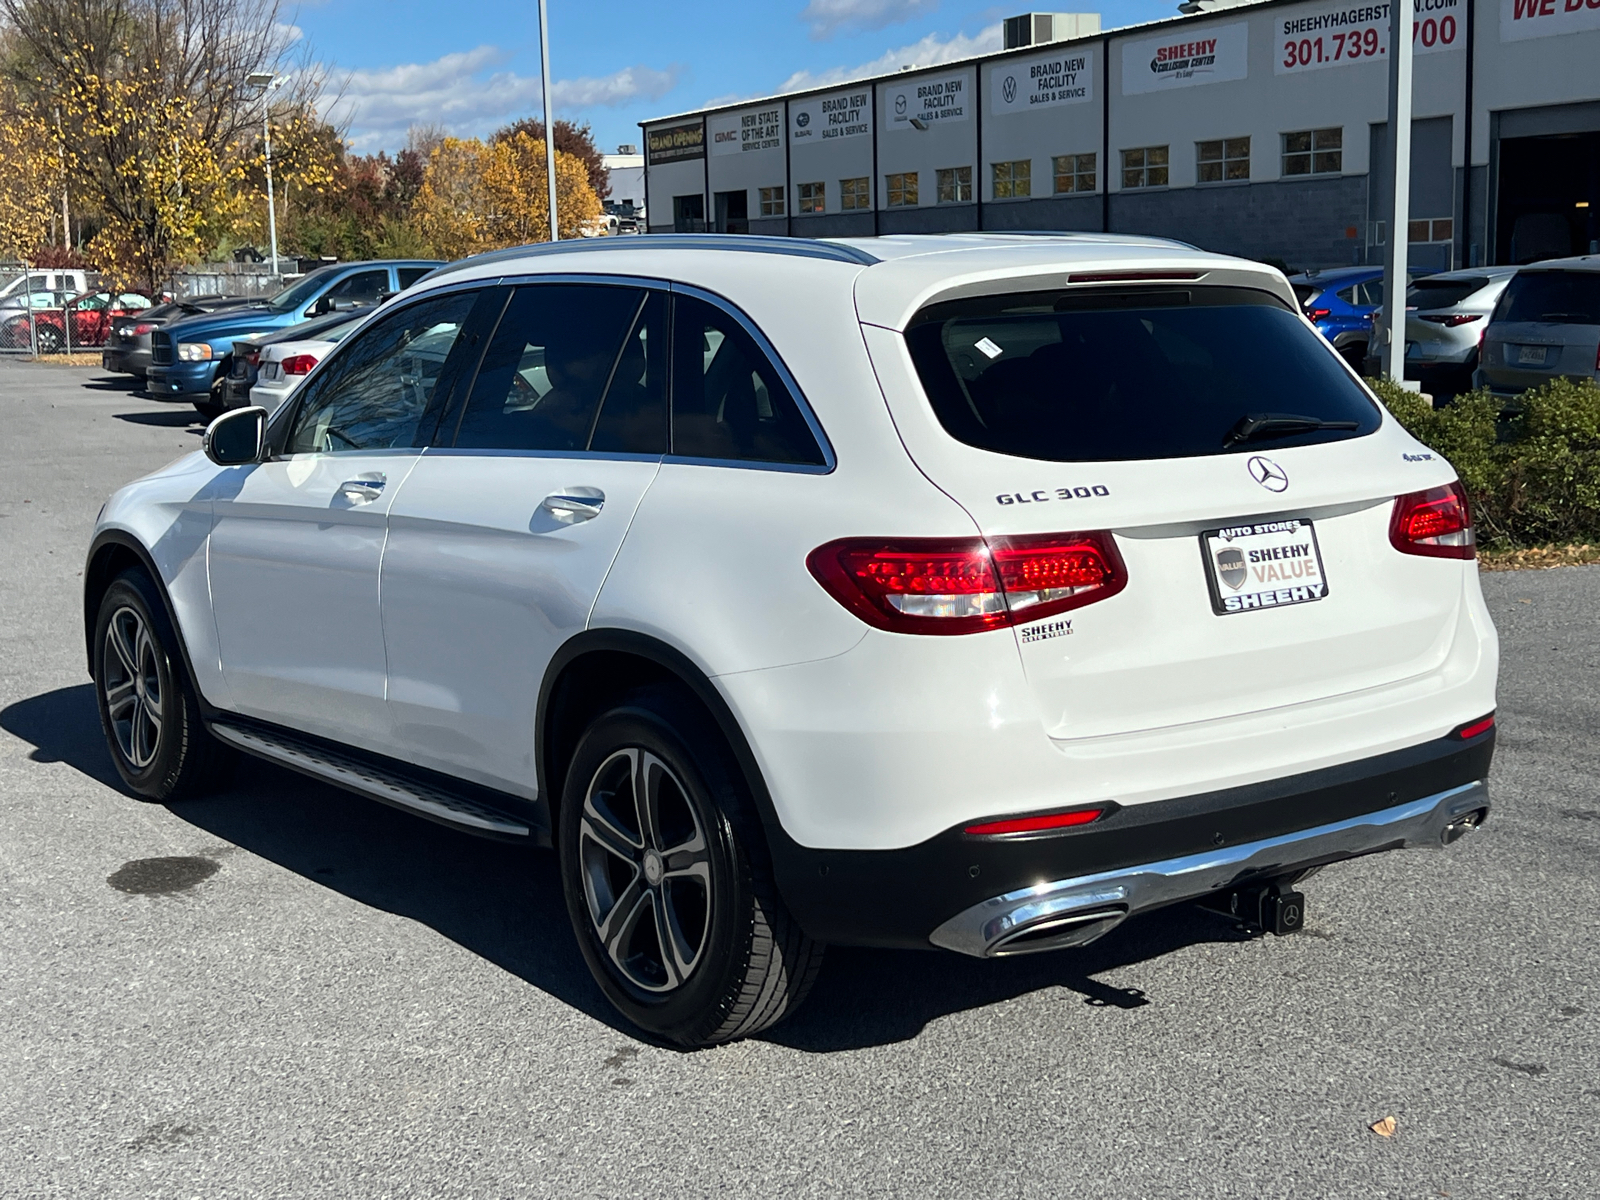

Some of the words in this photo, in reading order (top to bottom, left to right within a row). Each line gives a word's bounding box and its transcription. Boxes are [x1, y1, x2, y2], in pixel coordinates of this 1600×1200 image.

[1514, 0, 1556, 20] WE
[1157, 39, 1217, 62] SHEEHY
[1030, 61, 1062, 79] BRAND
[1064, 57, 1085, 72] NEW
[1157, 59, 1190, 73] COLLISION
[1190, 55, 1216, 68] CENTER
[917, 83, 943, 99] BRAND
[945, 80, 963, 93] NEW
[1038, 73, 1077, 91] FACILITY
[822, 97, 848, 113] BRAND
[850, 93, 867, 108] NEW
[923, 94, 956, 110] FACILITY
[1029, 93, 1050, 104] SALES
[1051, 92, 1057, 101] &
[1058, 87, 1086, 100] SERVICE
[741, 114, 757, 128] NEW
[758, 110, 779, 125] STATE
[828, 109, 860, 126] FACILITY
[917, 111, 933, 121] SALES
[934, 110, 939, 119] &
[940, 107, 963, 119] SERVICE
[649, 134, 673, 150] GRAND
[673, 130, 703, 147] OPENING
[715, 130, 737, 143] GMC
[741, 129, 750, 141] OF
[751, 126, 764, 140] THE
[765, 124, 779, 138] ART
[822, 126, 840, 139] SALES
[840, 125, 845, 136] &
[845, 123, 868, 136] SERVICE
[741, 140, 761, 152] SERVICE
[761, 138, 780, 149] CENTER
[995, 490, 1049, 505] GLC
[1054, 485, 1110, 500] 300
[1218, 526, 1252, 540] AUTO
[1254, 520, 1302, 534] STORES
[1248, 543, 1310, 563] SHEEHY
[1218, 561, 1245, 572] VALUE
[1251, 559, 1317, 583] VALUE
[1223, 583, 1325, 611] SHEEHY
[1021, 619, 1073, 637] SHEEHY
